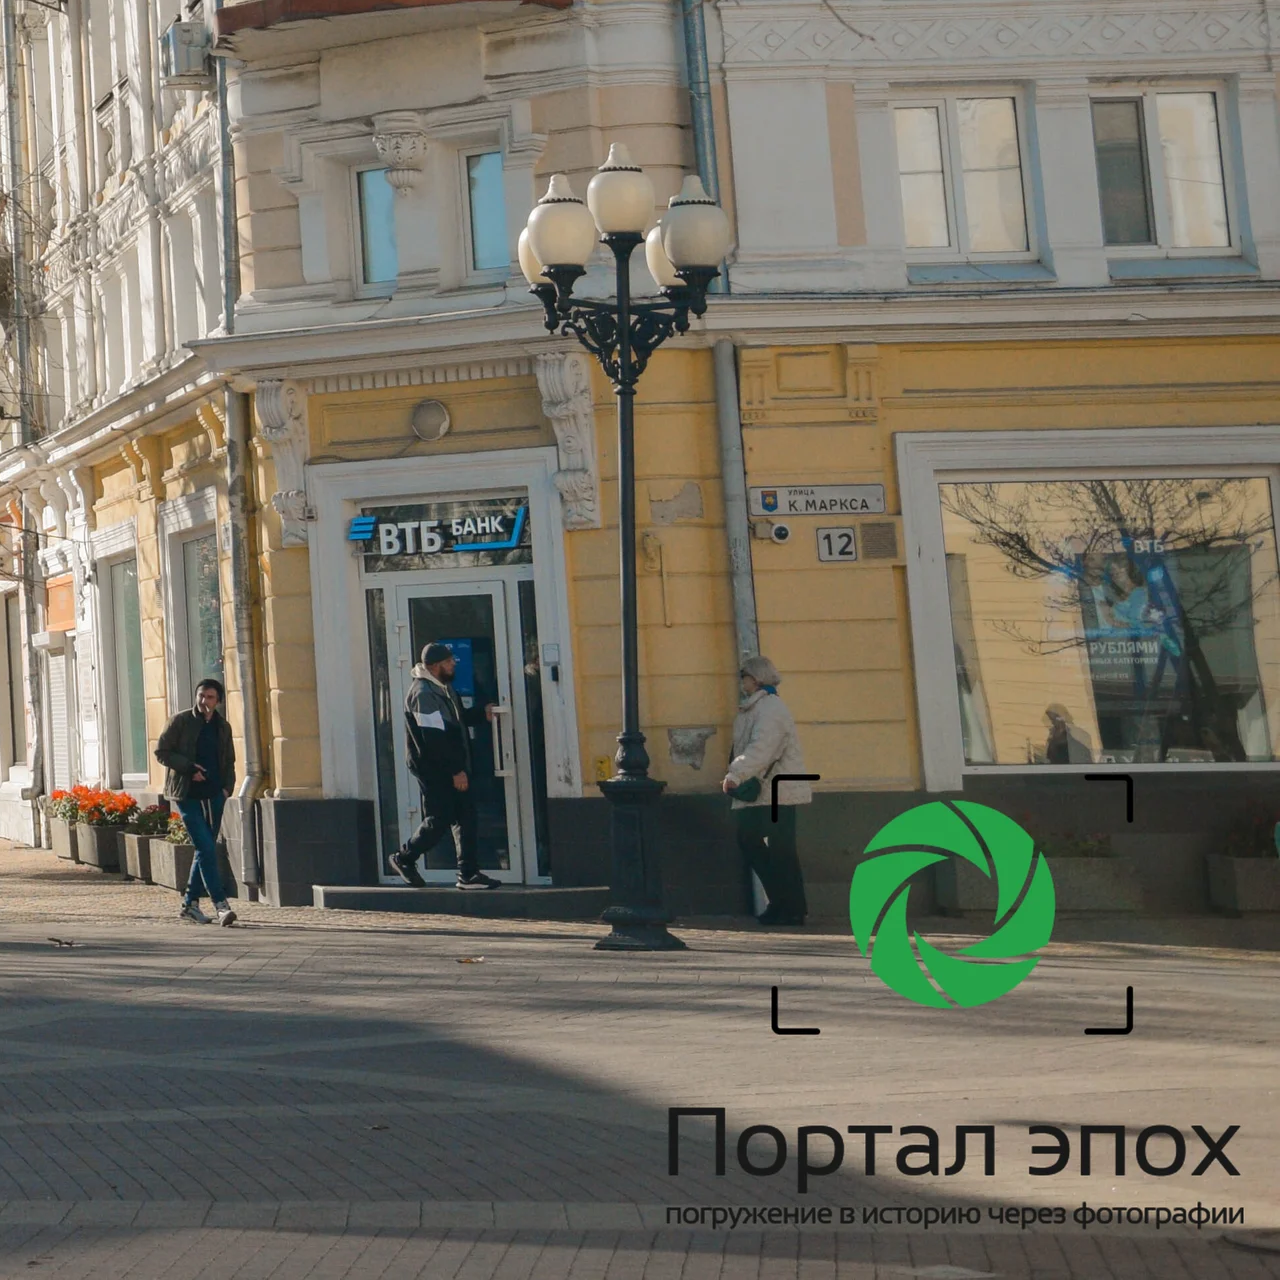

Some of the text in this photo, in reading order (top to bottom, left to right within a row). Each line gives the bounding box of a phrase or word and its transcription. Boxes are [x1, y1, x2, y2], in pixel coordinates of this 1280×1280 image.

[789, 498, 869, 512] К. МАРКСА
[378, 515, 504, 556] ВТБ БАНК
[823, 533, 853, 556] 12
[1133, 538, 1165, 553] ВТБ
[1090, 641, 1158, 654] РУБЛЯМИ
